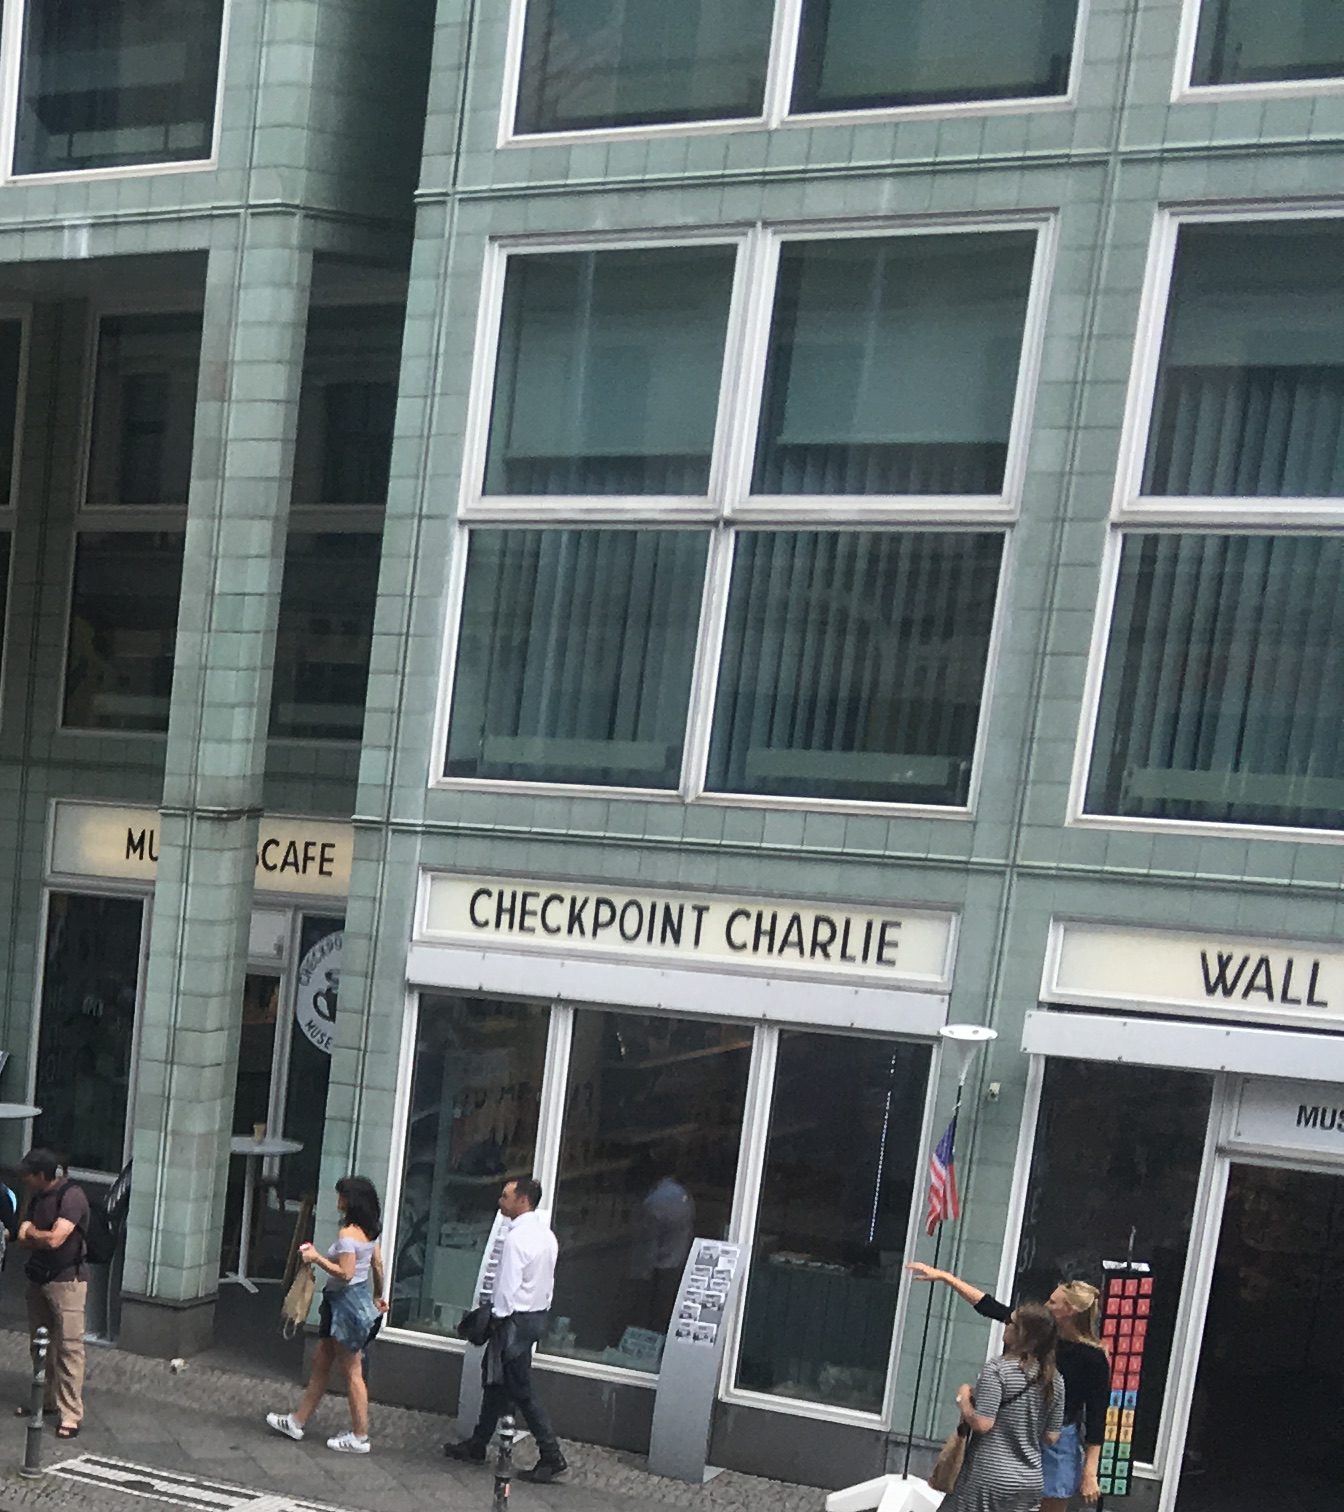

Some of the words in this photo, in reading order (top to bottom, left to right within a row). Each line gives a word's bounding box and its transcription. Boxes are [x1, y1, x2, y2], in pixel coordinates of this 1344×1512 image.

[469, 887, 710, 948] CHECKPOINT
[725, 907, 902, 966] CHARLIE
[1200, 949, 1328, 1007] WALL
